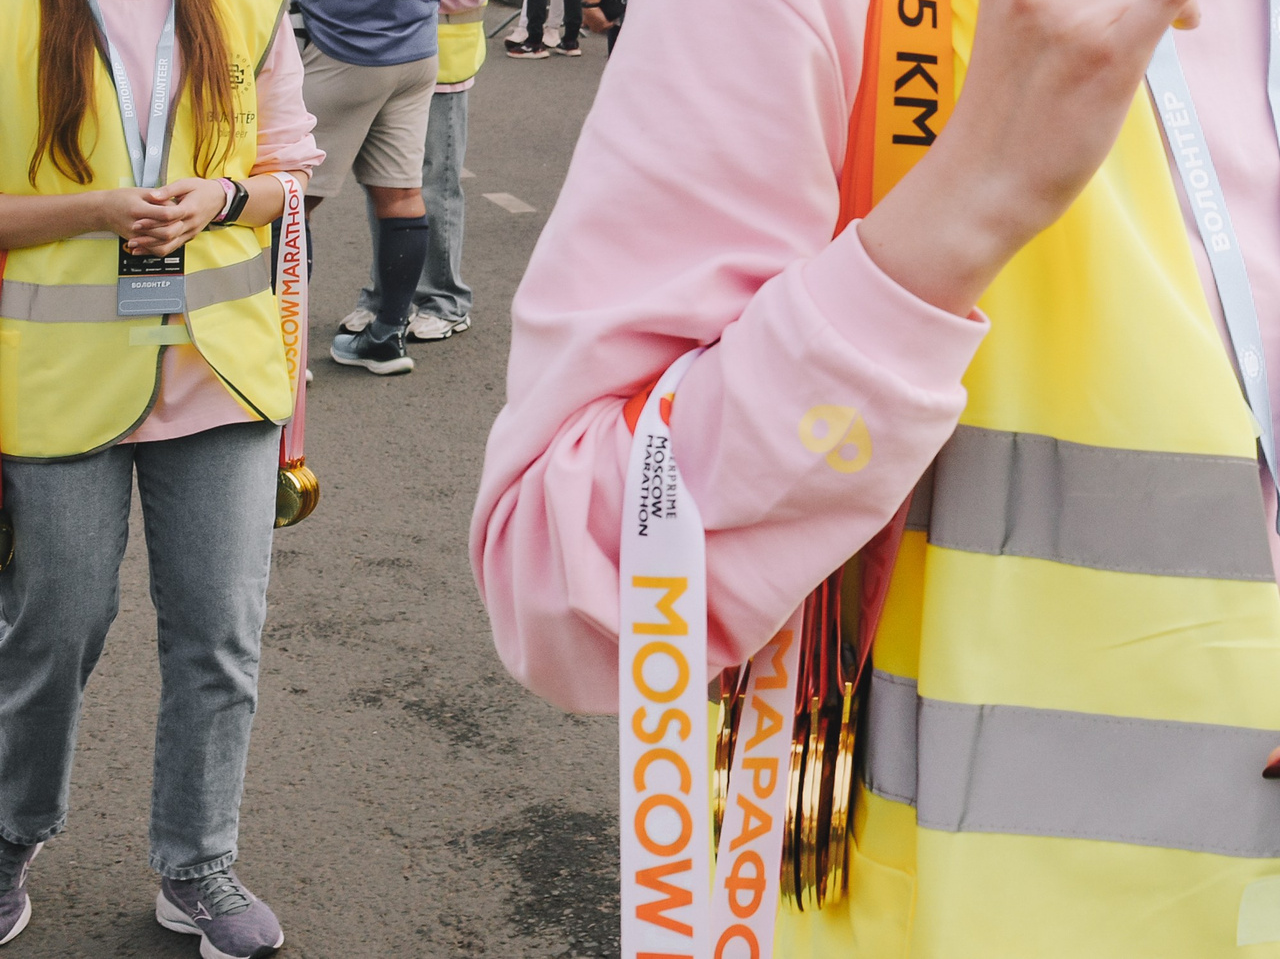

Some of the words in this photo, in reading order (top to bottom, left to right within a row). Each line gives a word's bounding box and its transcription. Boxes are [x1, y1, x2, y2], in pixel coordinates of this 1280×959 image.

[114, 62, 134, 118] ВОЛОНТЁР
[153, 58, 169, 117] VOLUNTEER
[1164, 92, 1232, 253] ВОЛОНТЁР
[282, 179, 300, 296] MARATHON
[131, 280, 171, 289] ВОЛОНТЁР
[281, 299, 300, 390] OSCOW
[638, 434, 653, 537] MARATHON
[651, 435, 669, 519] MOSCOW
[632, 576, 694, 937] MOSCOW
